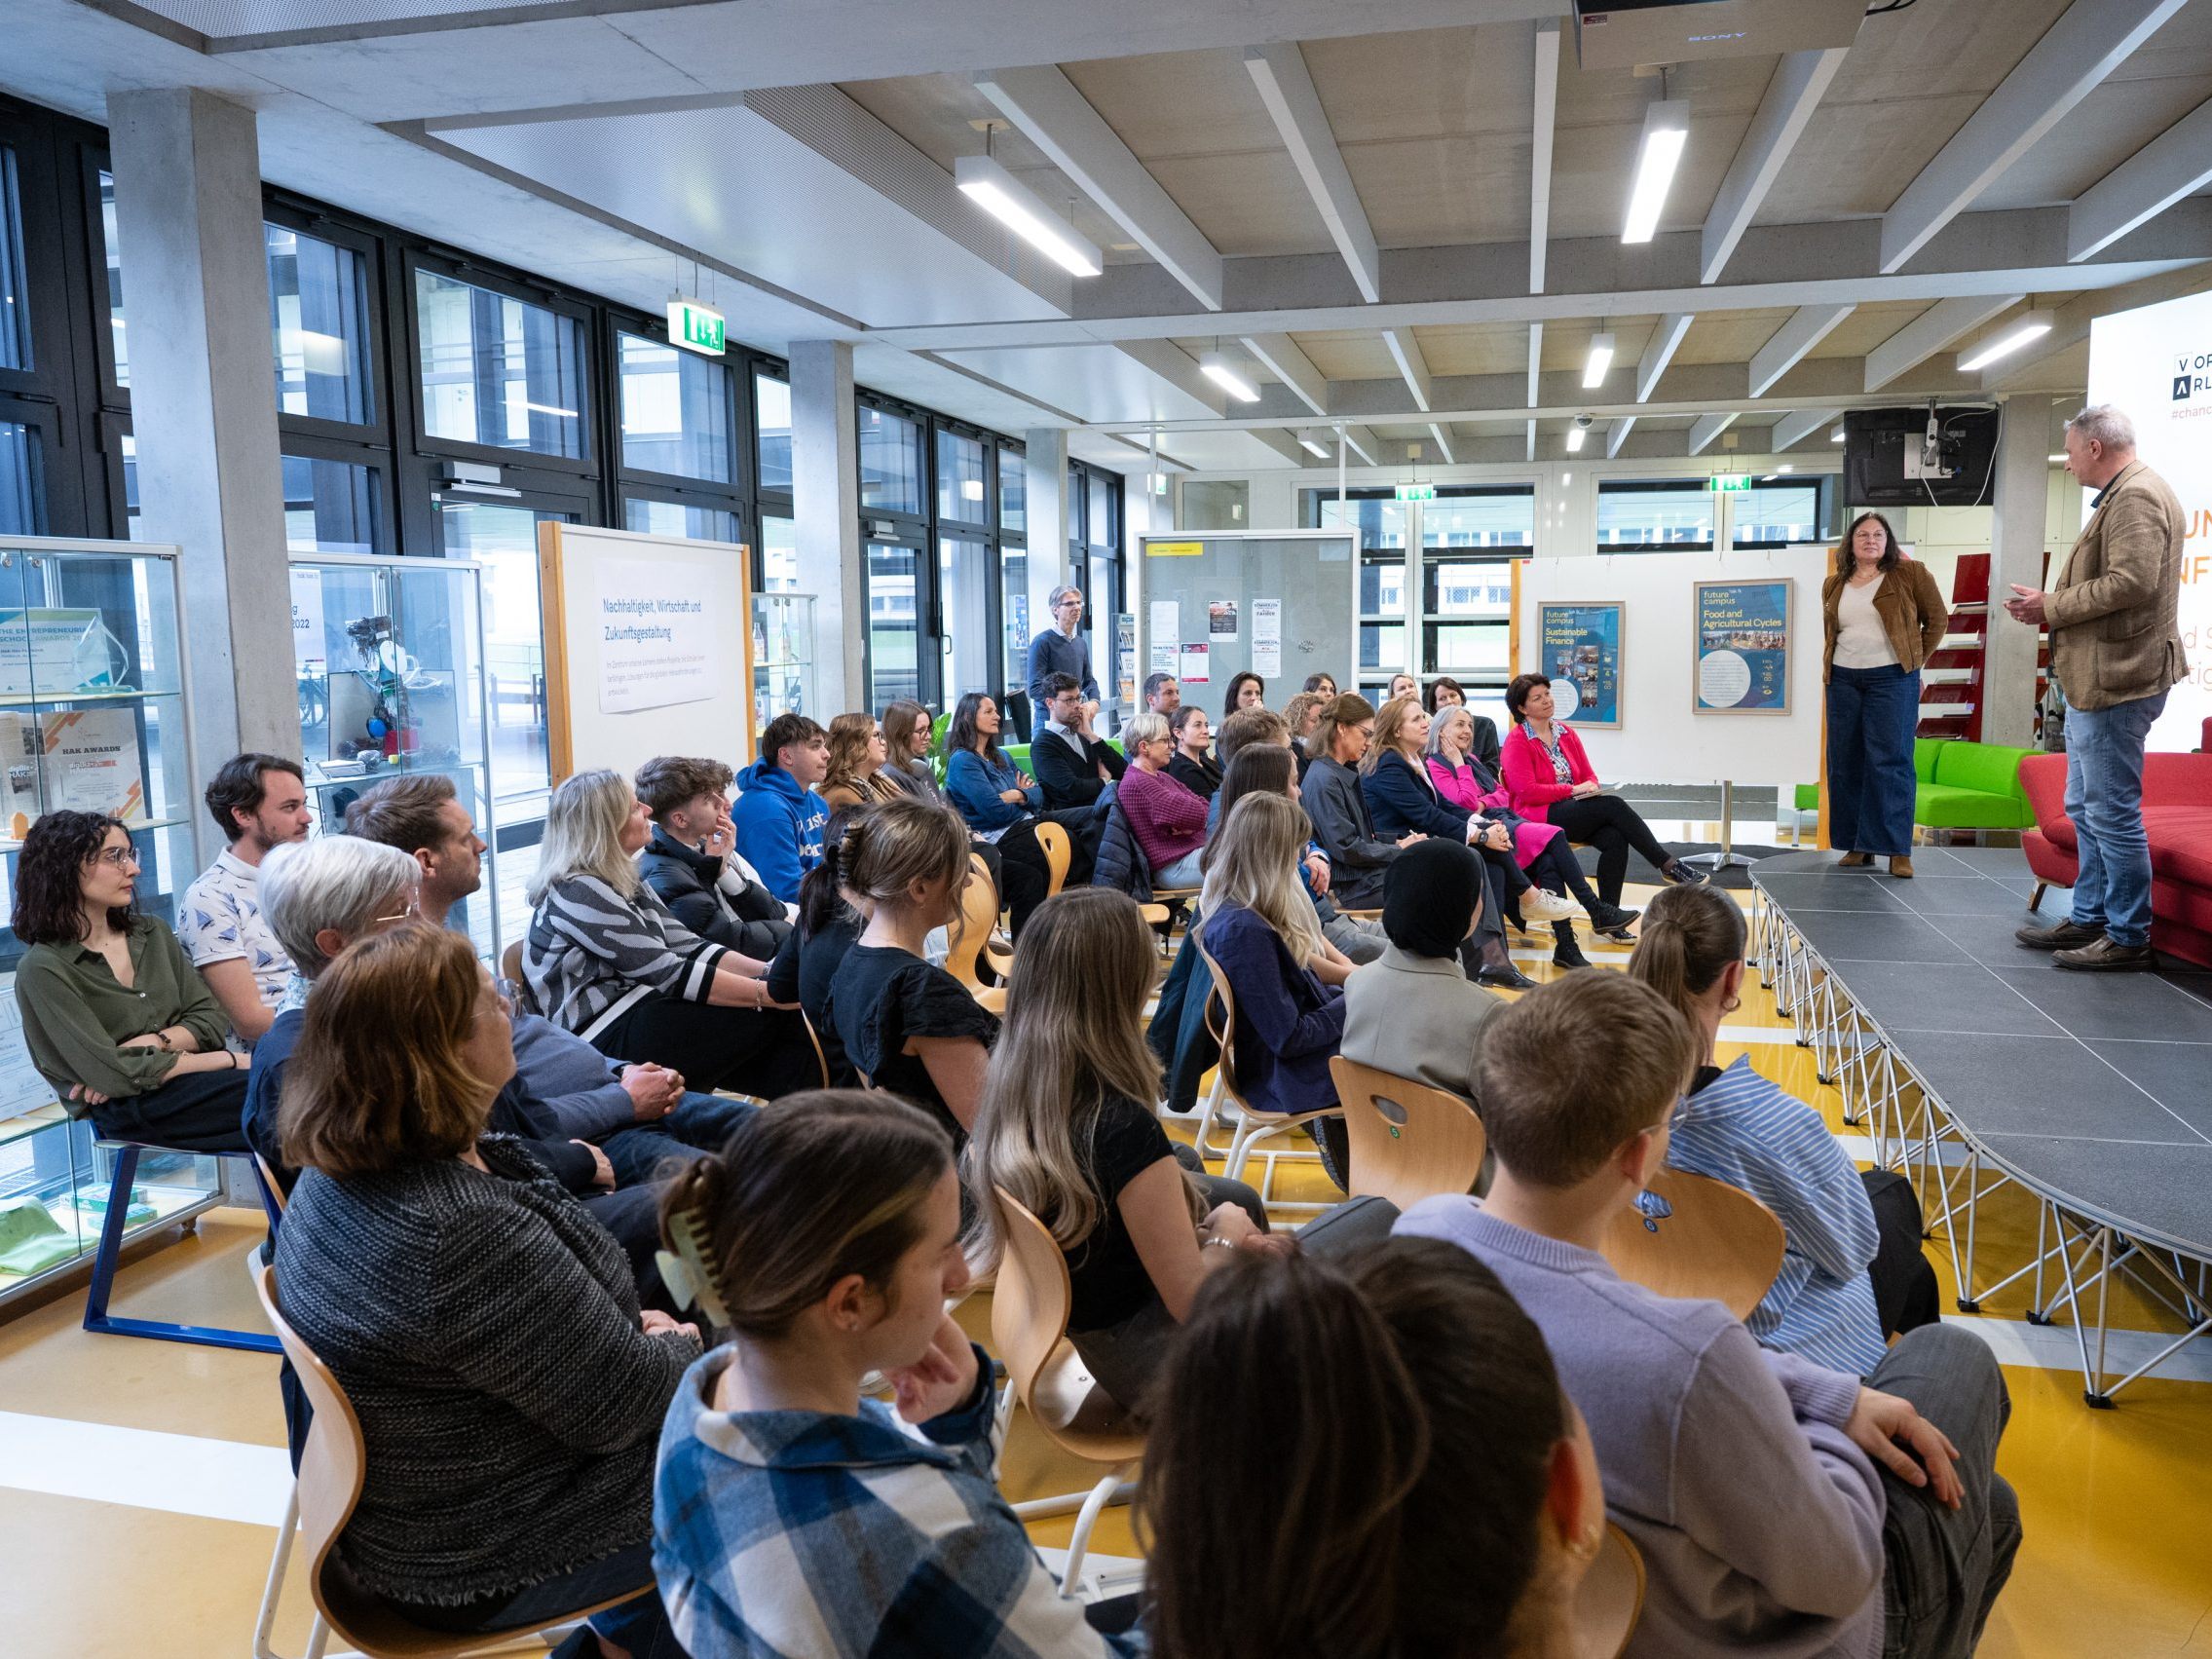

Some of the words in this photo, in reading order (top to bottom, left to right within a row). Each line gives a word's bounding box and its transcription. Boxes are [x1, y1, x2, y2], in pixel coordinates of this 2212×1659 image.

[603, 598, 656, 617] Nachhaltigkeit,
[656, 599, 690, 613] Wirtschaft
[691, 599, 701, 612] und
[1704, 610, 1725, 619] Food
[1726, 609, 1743, 618] and
[1704, 619, 1752, 630] Agricultural
[1753, 619, 1782, 628] Cycles
[605, 625, 671, 643] Zukunftsgestaltung
[1545, 627, 1588, 636] Sustainable
[1545, 636, 1575, 645] Finance
[84, 745, 122, 754] AWARDS
